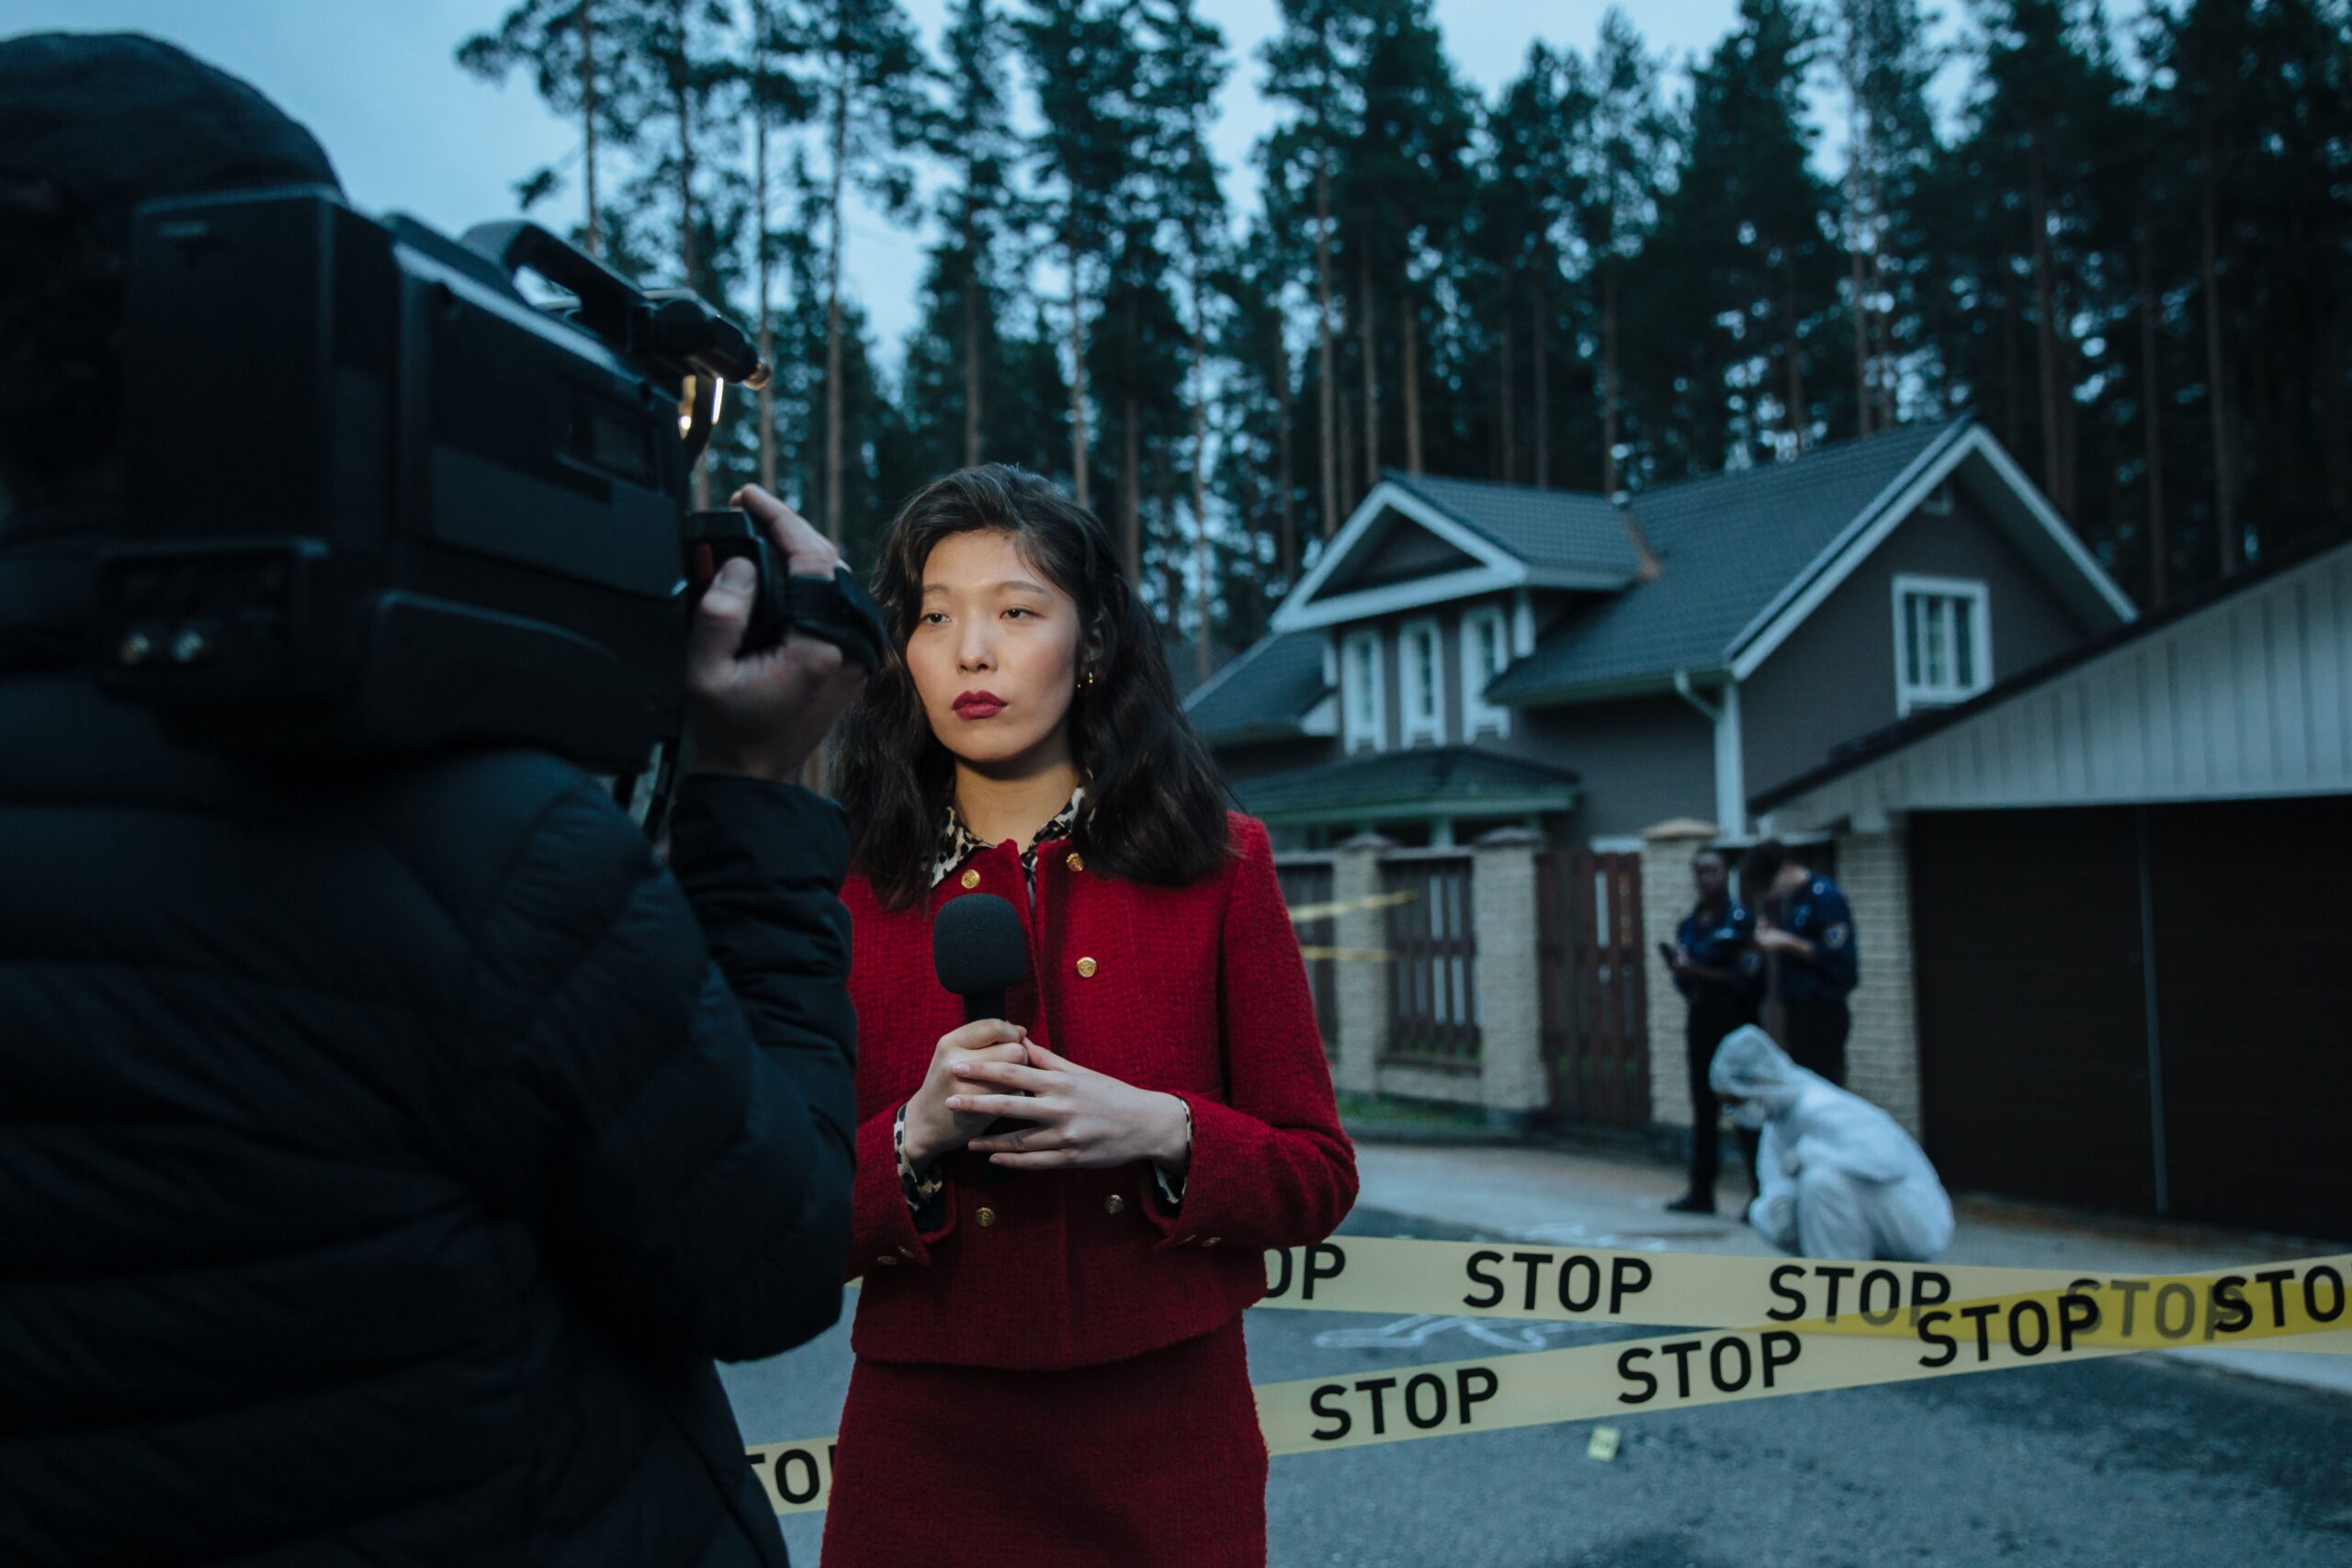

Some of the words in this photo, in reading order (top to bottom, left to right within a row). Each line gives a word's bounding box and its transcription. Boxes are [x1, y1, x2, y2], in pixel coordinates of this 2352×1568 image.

[1464, 1250, 1652, 1314] STOP
[1766, 1264, 1951, 1327] STOP
[1310, 1367, 1498, 1440] STOP
[1618, 1331, 1801, 1404] STOP
[1917, 1294, 2098, 1367] STOP
[2212, 1265, 2352, 1333] STO
